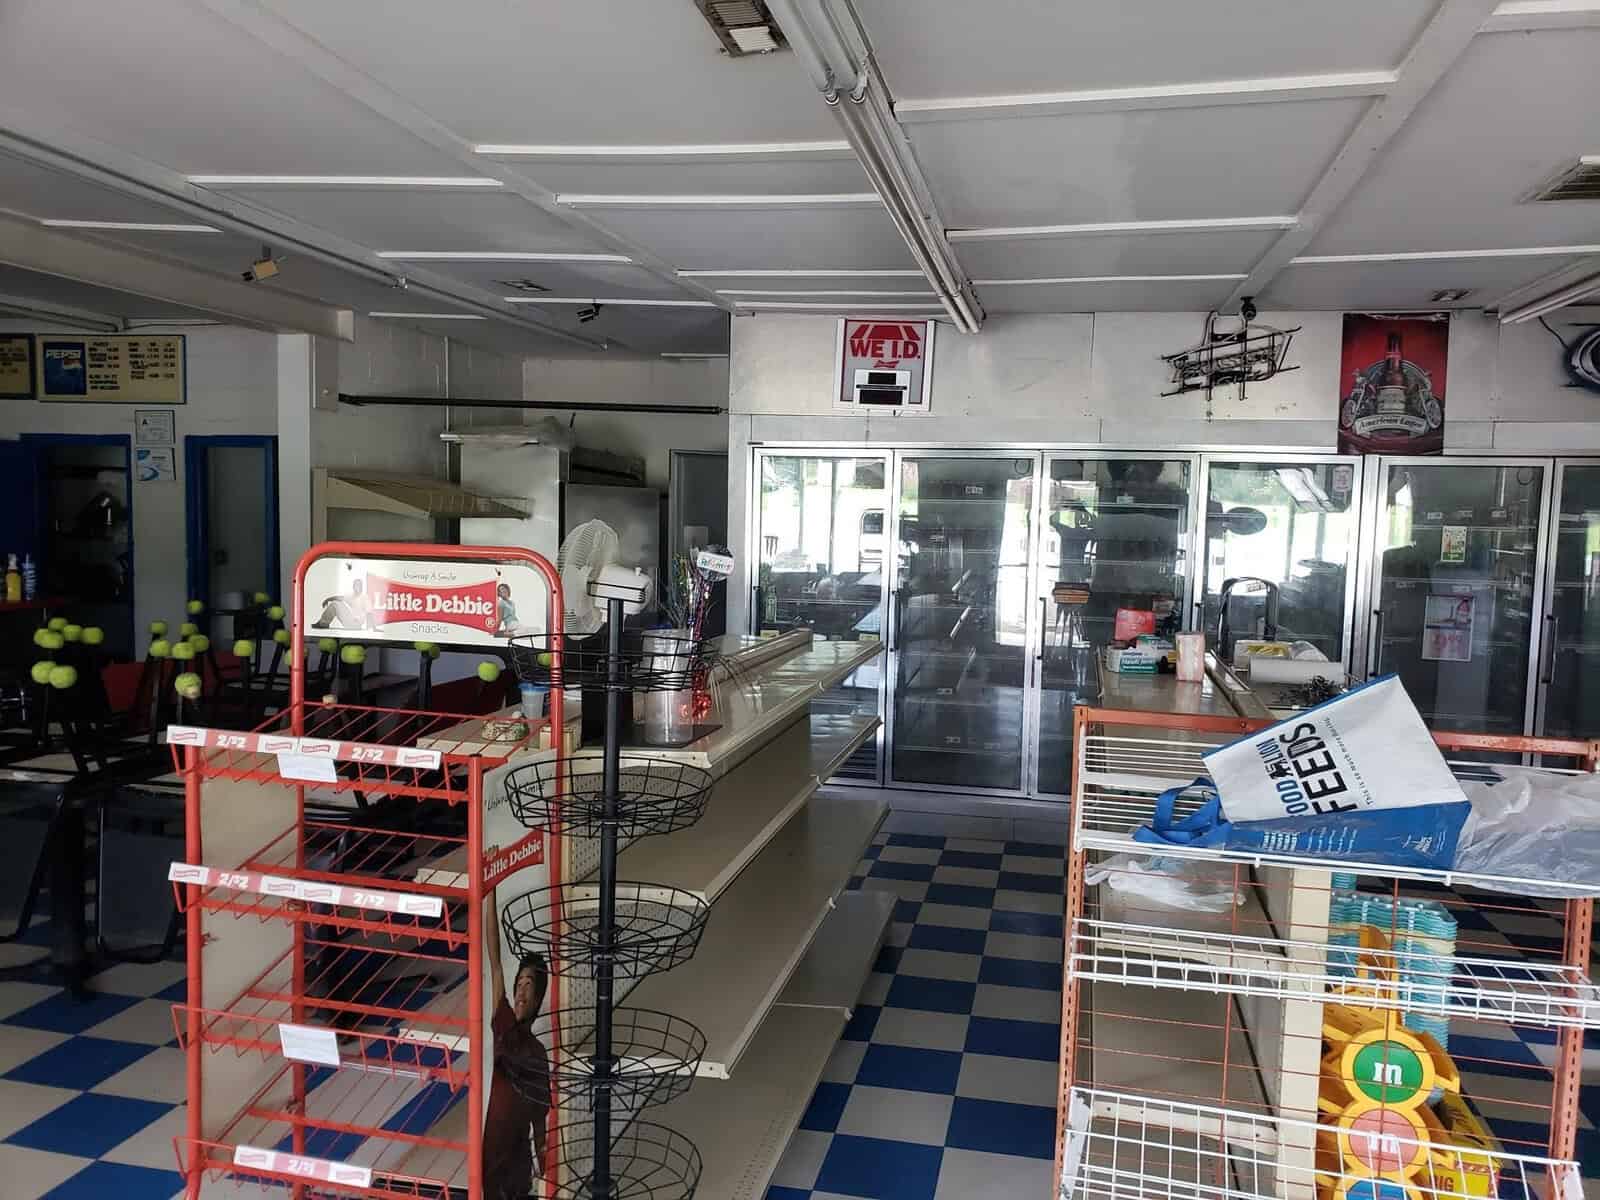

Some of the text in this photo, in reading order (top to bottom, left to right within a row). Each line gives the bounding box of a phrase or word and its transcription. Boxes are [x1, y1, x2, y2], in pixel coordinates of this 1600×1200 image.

[849, 339, 921, 359] WE I.D.
[374, 590, 494, 616] Little Debbie
[409, 622, 449, 635] Snacks
[1255, 737, 1284, 764] LION
[1279, 722, 1358, 815] FEEDS
[1276, 779, 1309, 817] OOD
[483, 839, 542, 883] Little Debbie
[1373, 1061, 1402, 1086] m
